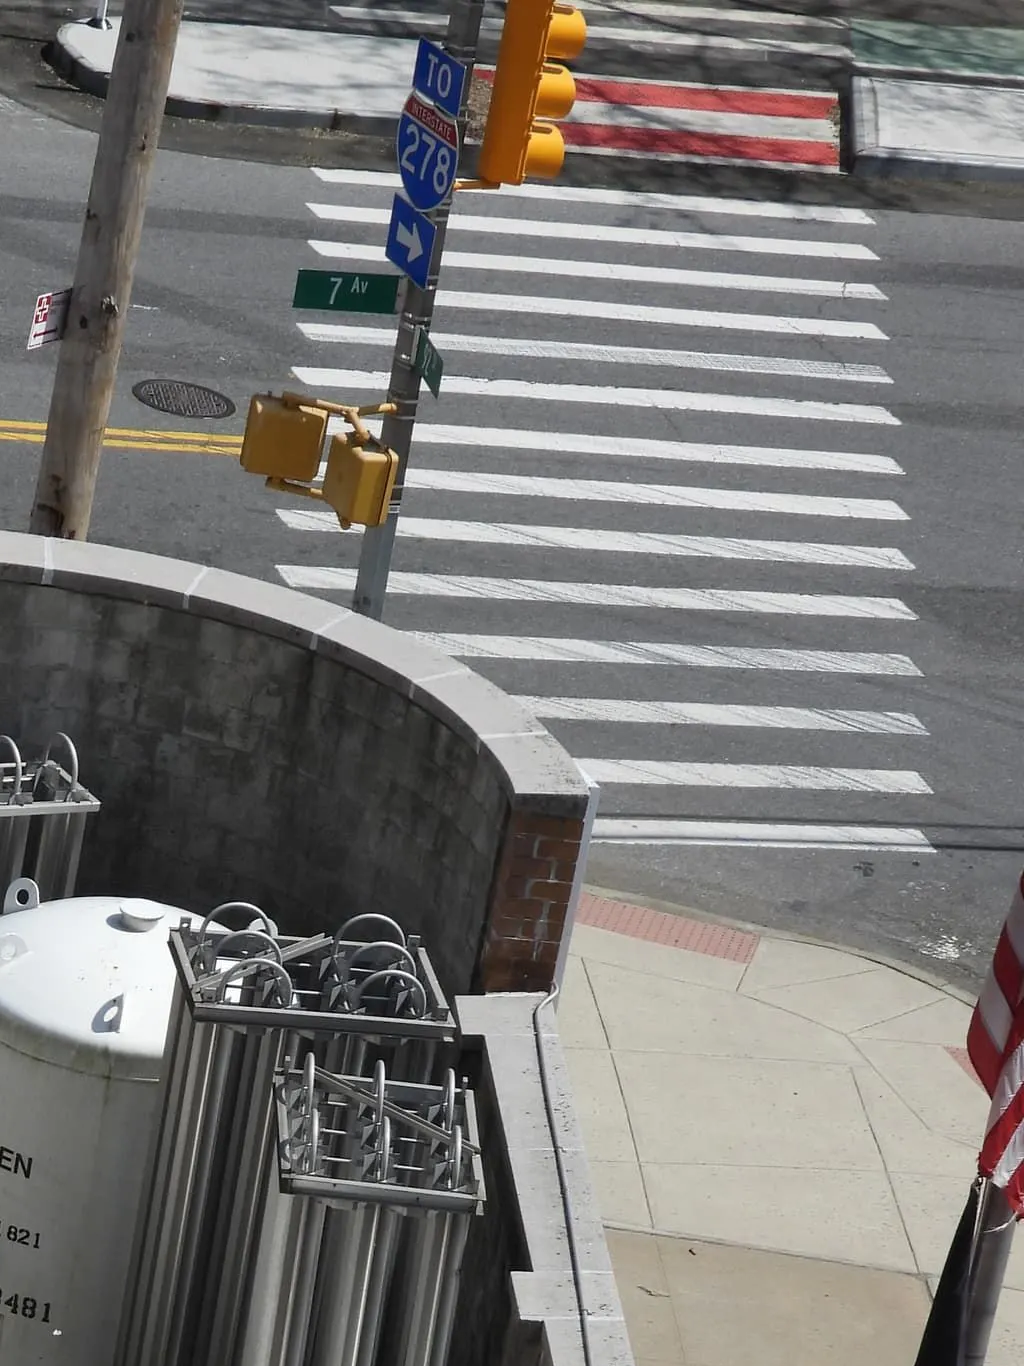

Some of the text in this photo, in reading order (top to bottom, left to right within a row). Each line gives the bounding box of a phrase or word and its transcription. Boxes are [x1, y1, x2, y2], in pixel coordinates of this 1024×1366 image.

[427, 53, 452, 98] TO
[411, 103, 452, 141] INTERSTATE
[400, 123, 451, 195] 278
[329, 276, 369, 304] 7 Av
